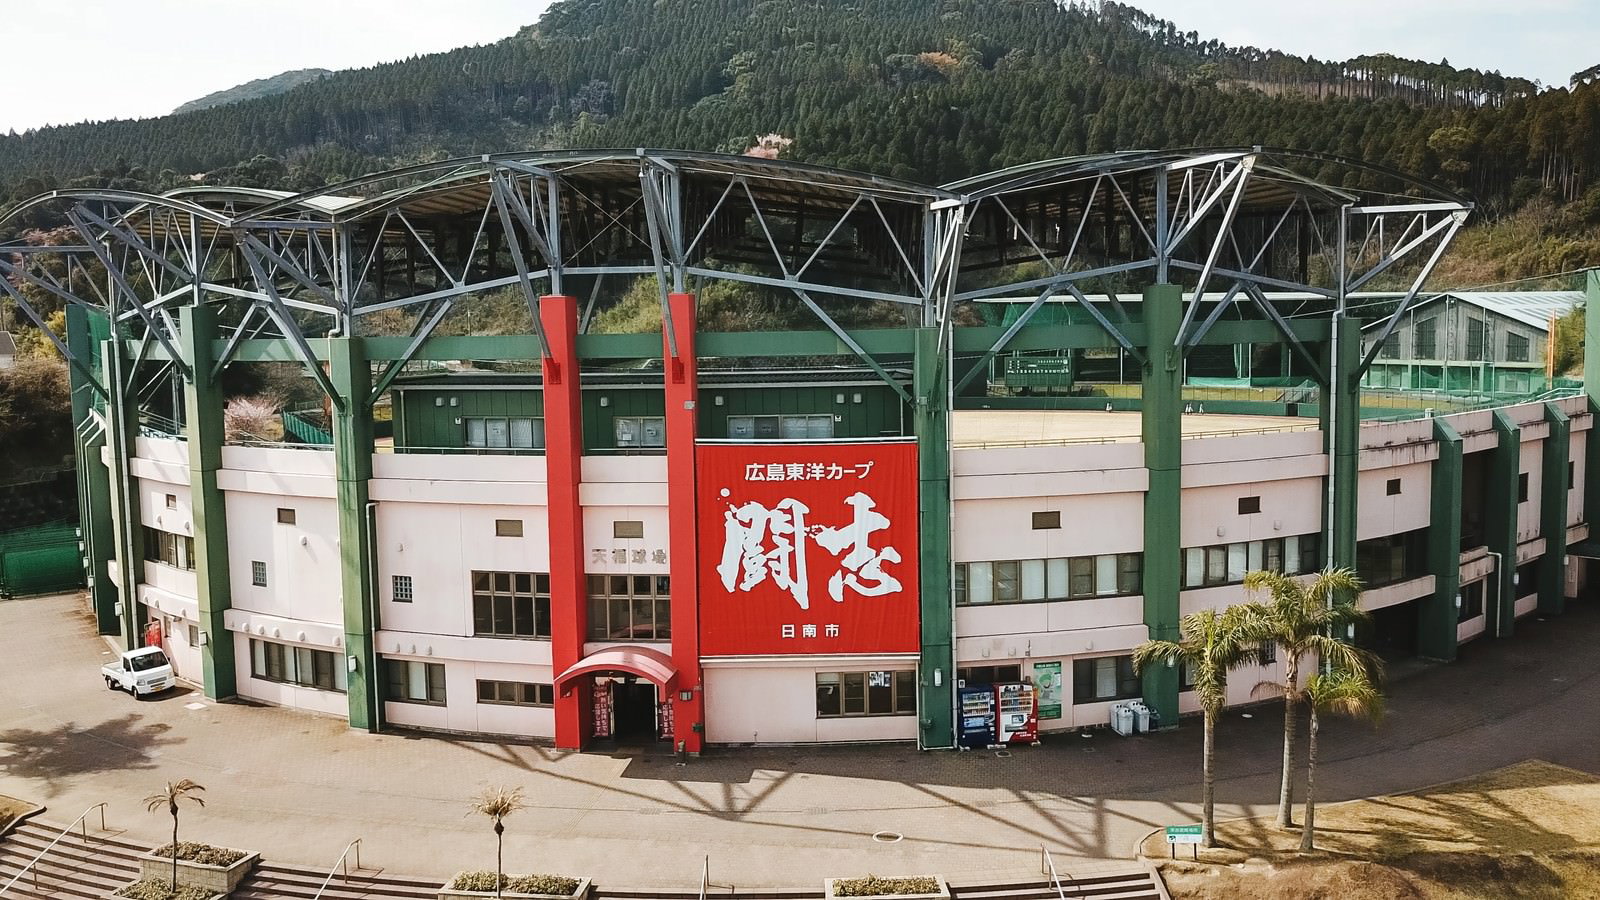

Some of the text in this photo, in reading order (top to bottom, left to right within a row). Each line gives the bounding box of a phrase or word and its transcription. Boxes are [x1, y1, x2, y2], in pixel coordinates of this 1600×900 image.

[744, 461, 874, 481] 広島東洋カープ
[592, 549, 666, 564] 天福球場
[716, 492, 903, 610] 闘志
[782, 624, 839, 638] 日南市
